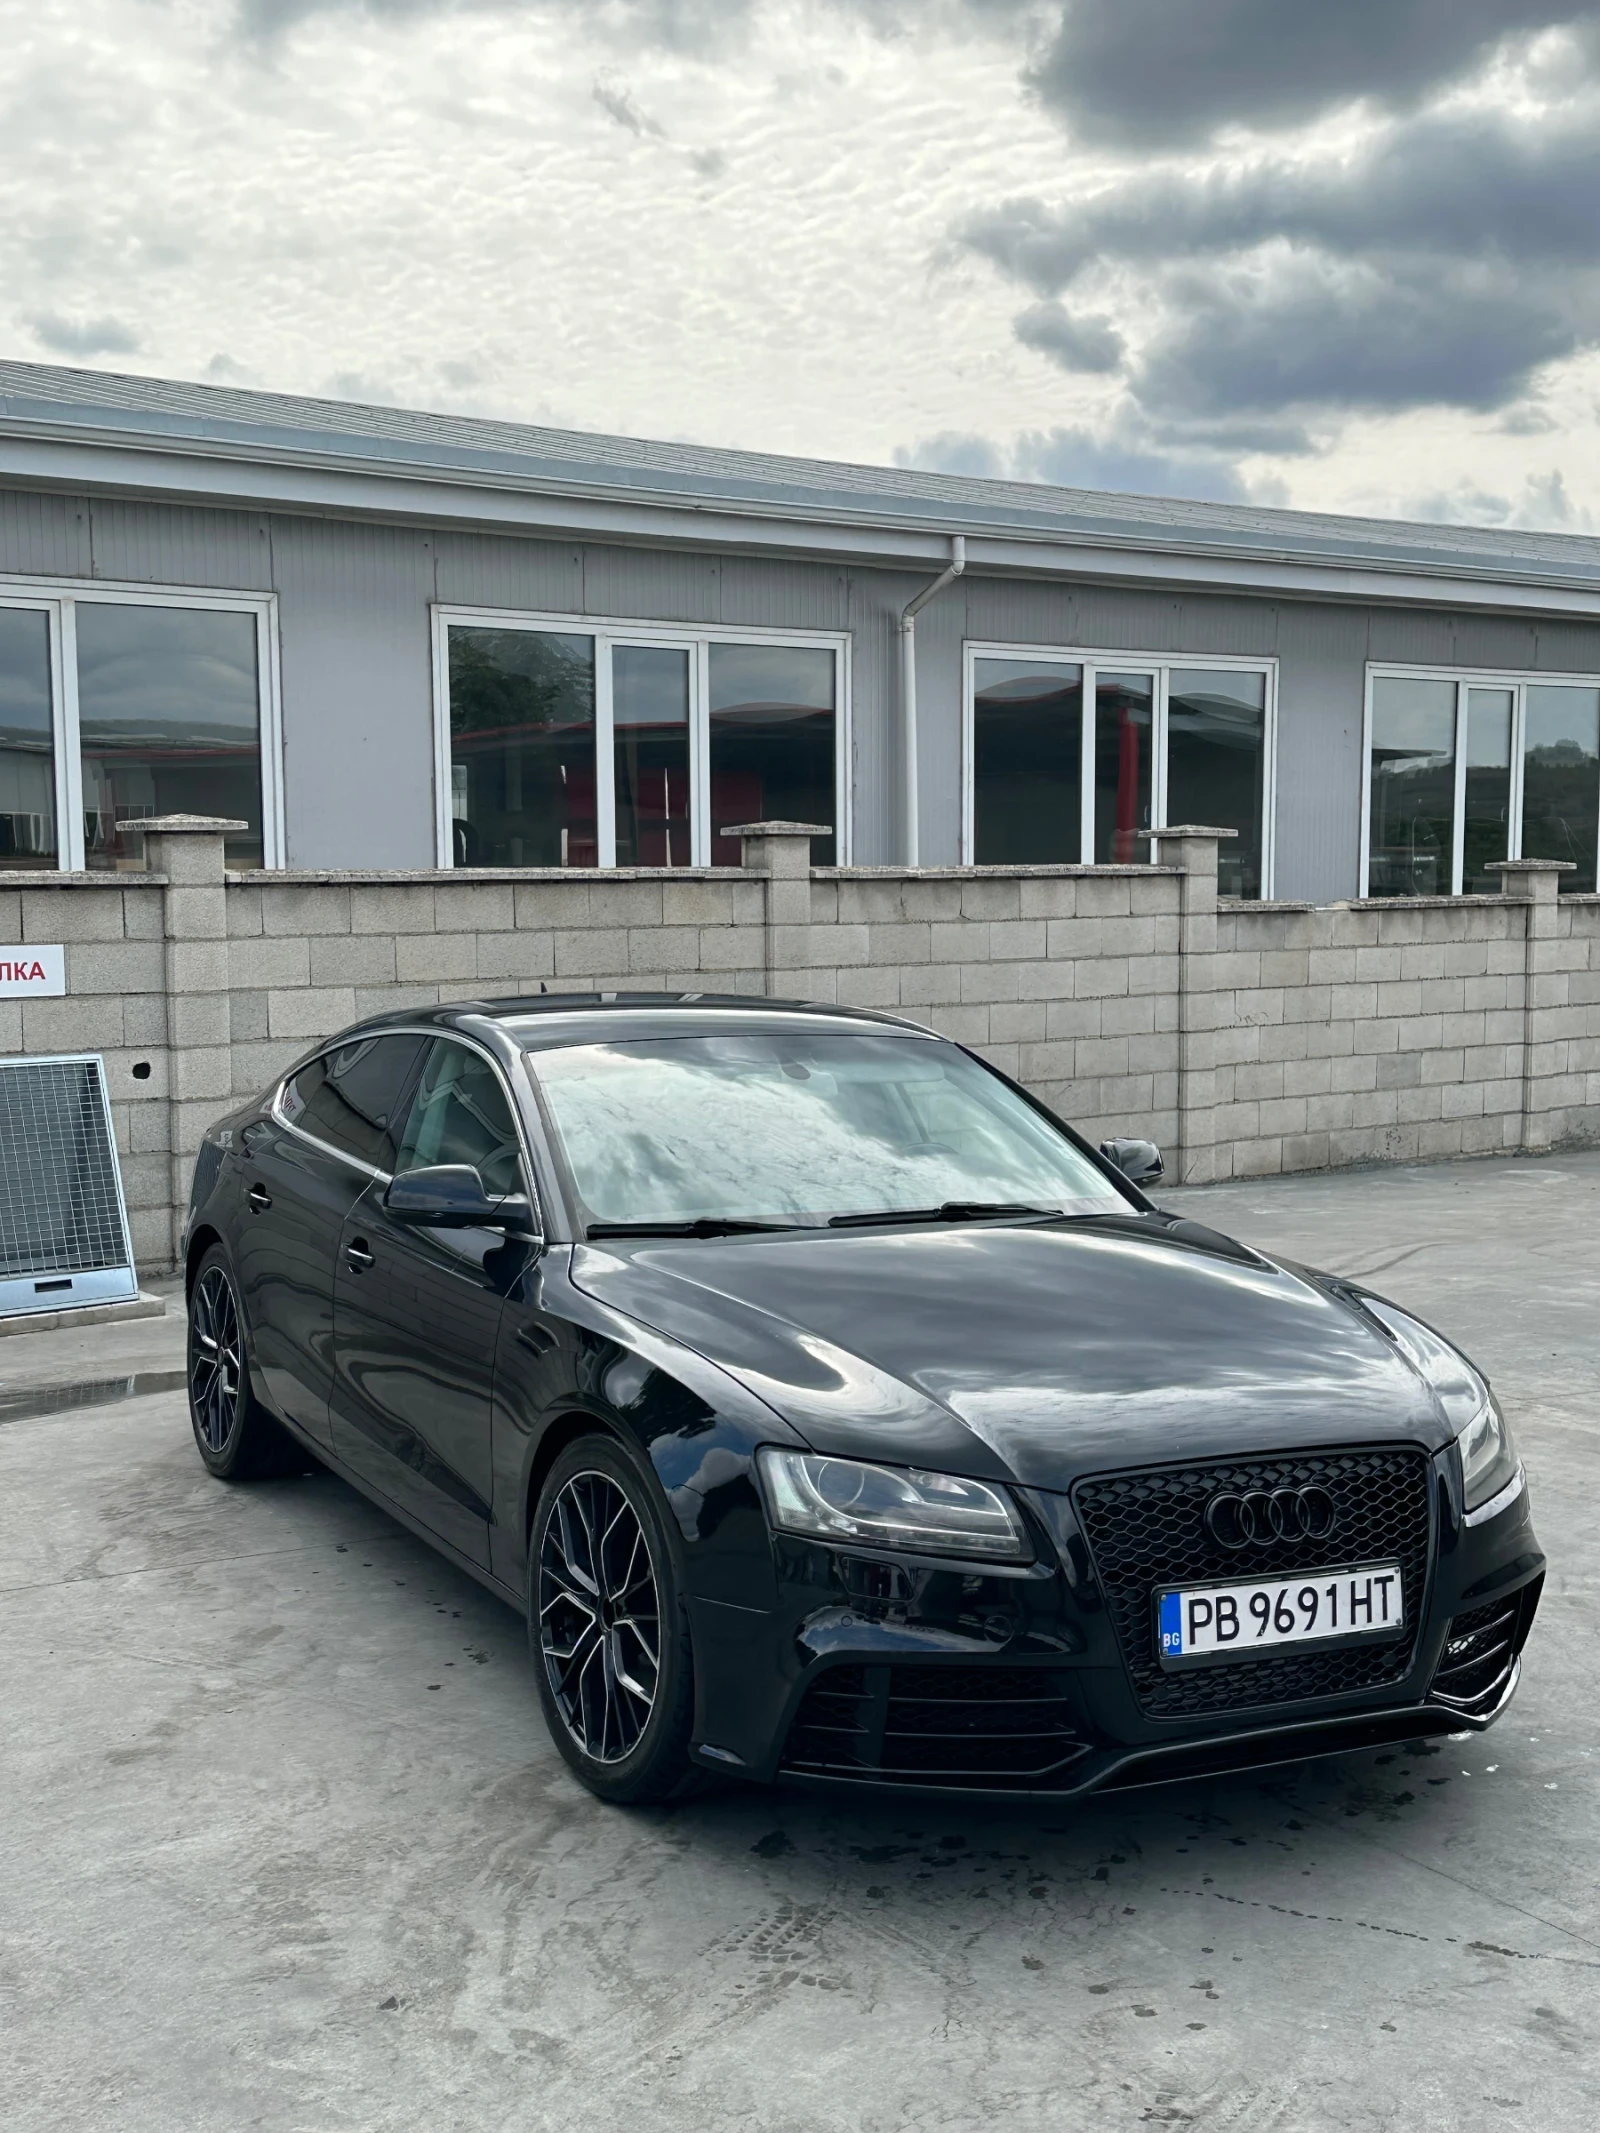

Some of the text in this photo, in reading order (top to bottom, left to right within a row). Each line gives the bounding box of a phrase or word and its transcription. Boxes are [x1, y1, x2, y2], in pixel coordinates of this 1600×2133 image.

[1188, 1575, 1394, 1645] PB 9691 HT
[1163, 1632, 1180, 1647] BG
